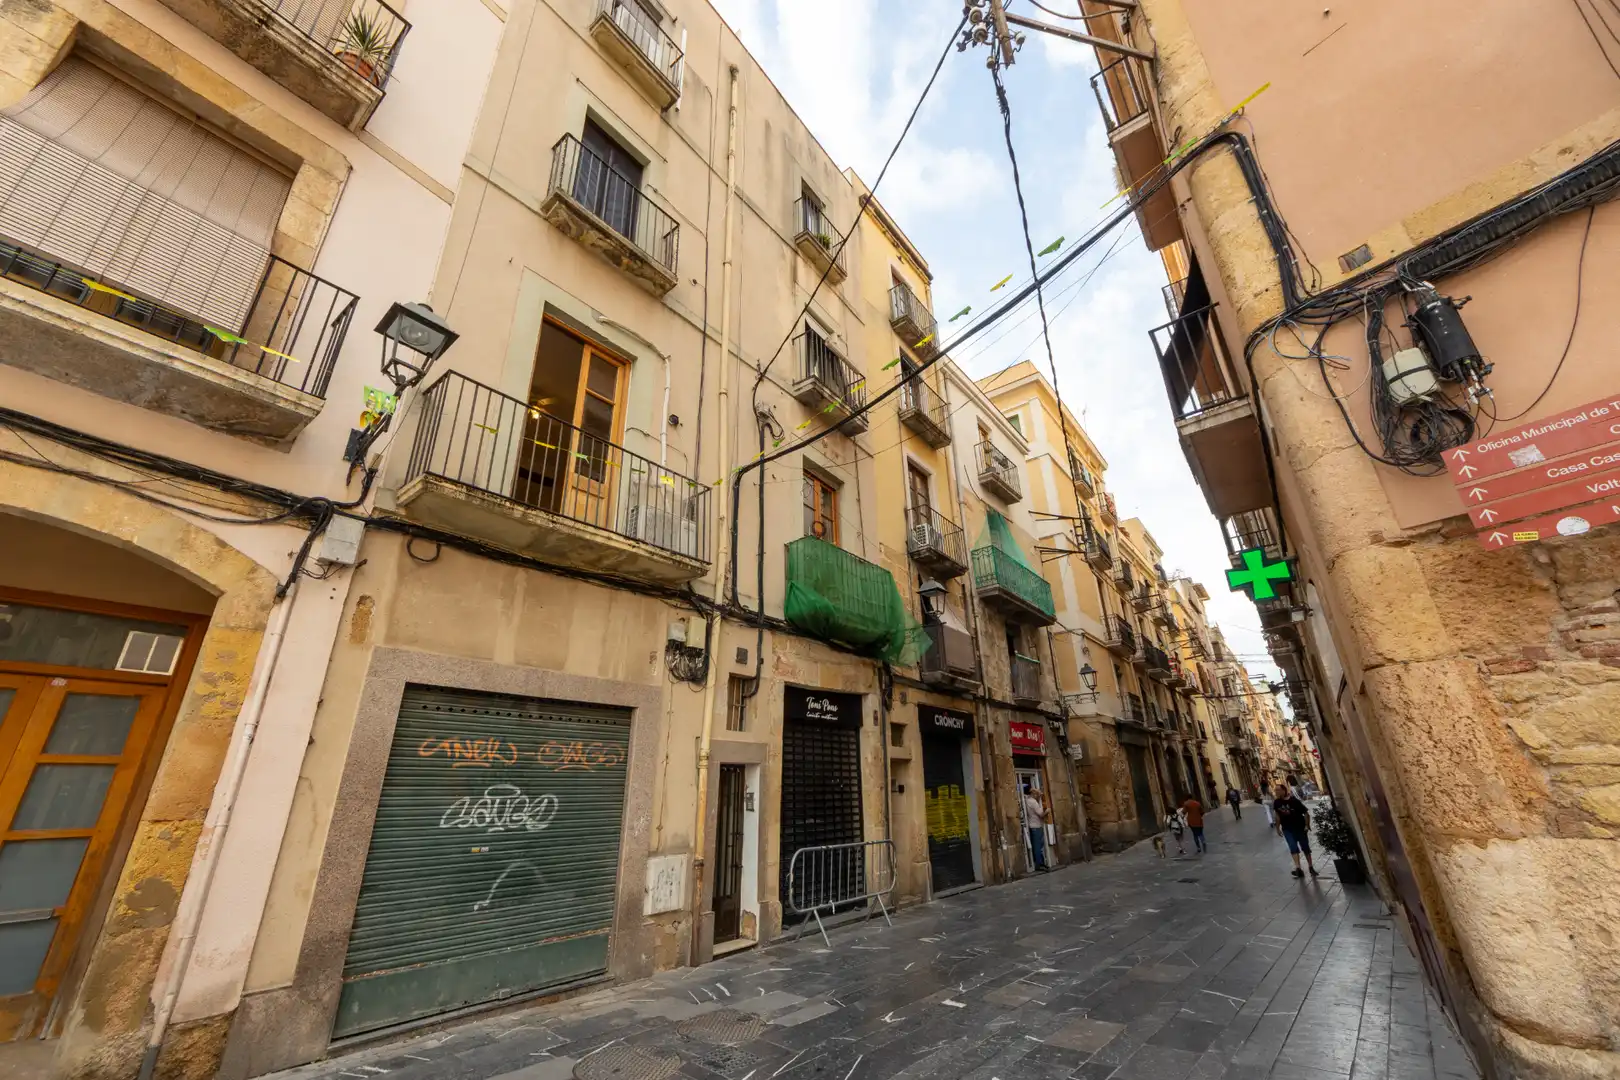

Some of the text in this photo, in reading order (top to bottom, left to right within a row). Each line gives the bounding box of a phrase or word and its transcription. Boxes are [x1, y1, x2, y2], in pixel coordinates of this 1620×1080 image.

[1477, 435, 1521, 453] Oficina
[1521, 412, 1589, 440] Municipal
[1589, 407, 1609, 418] de
[1547, 462, 1589, 478] Casa
